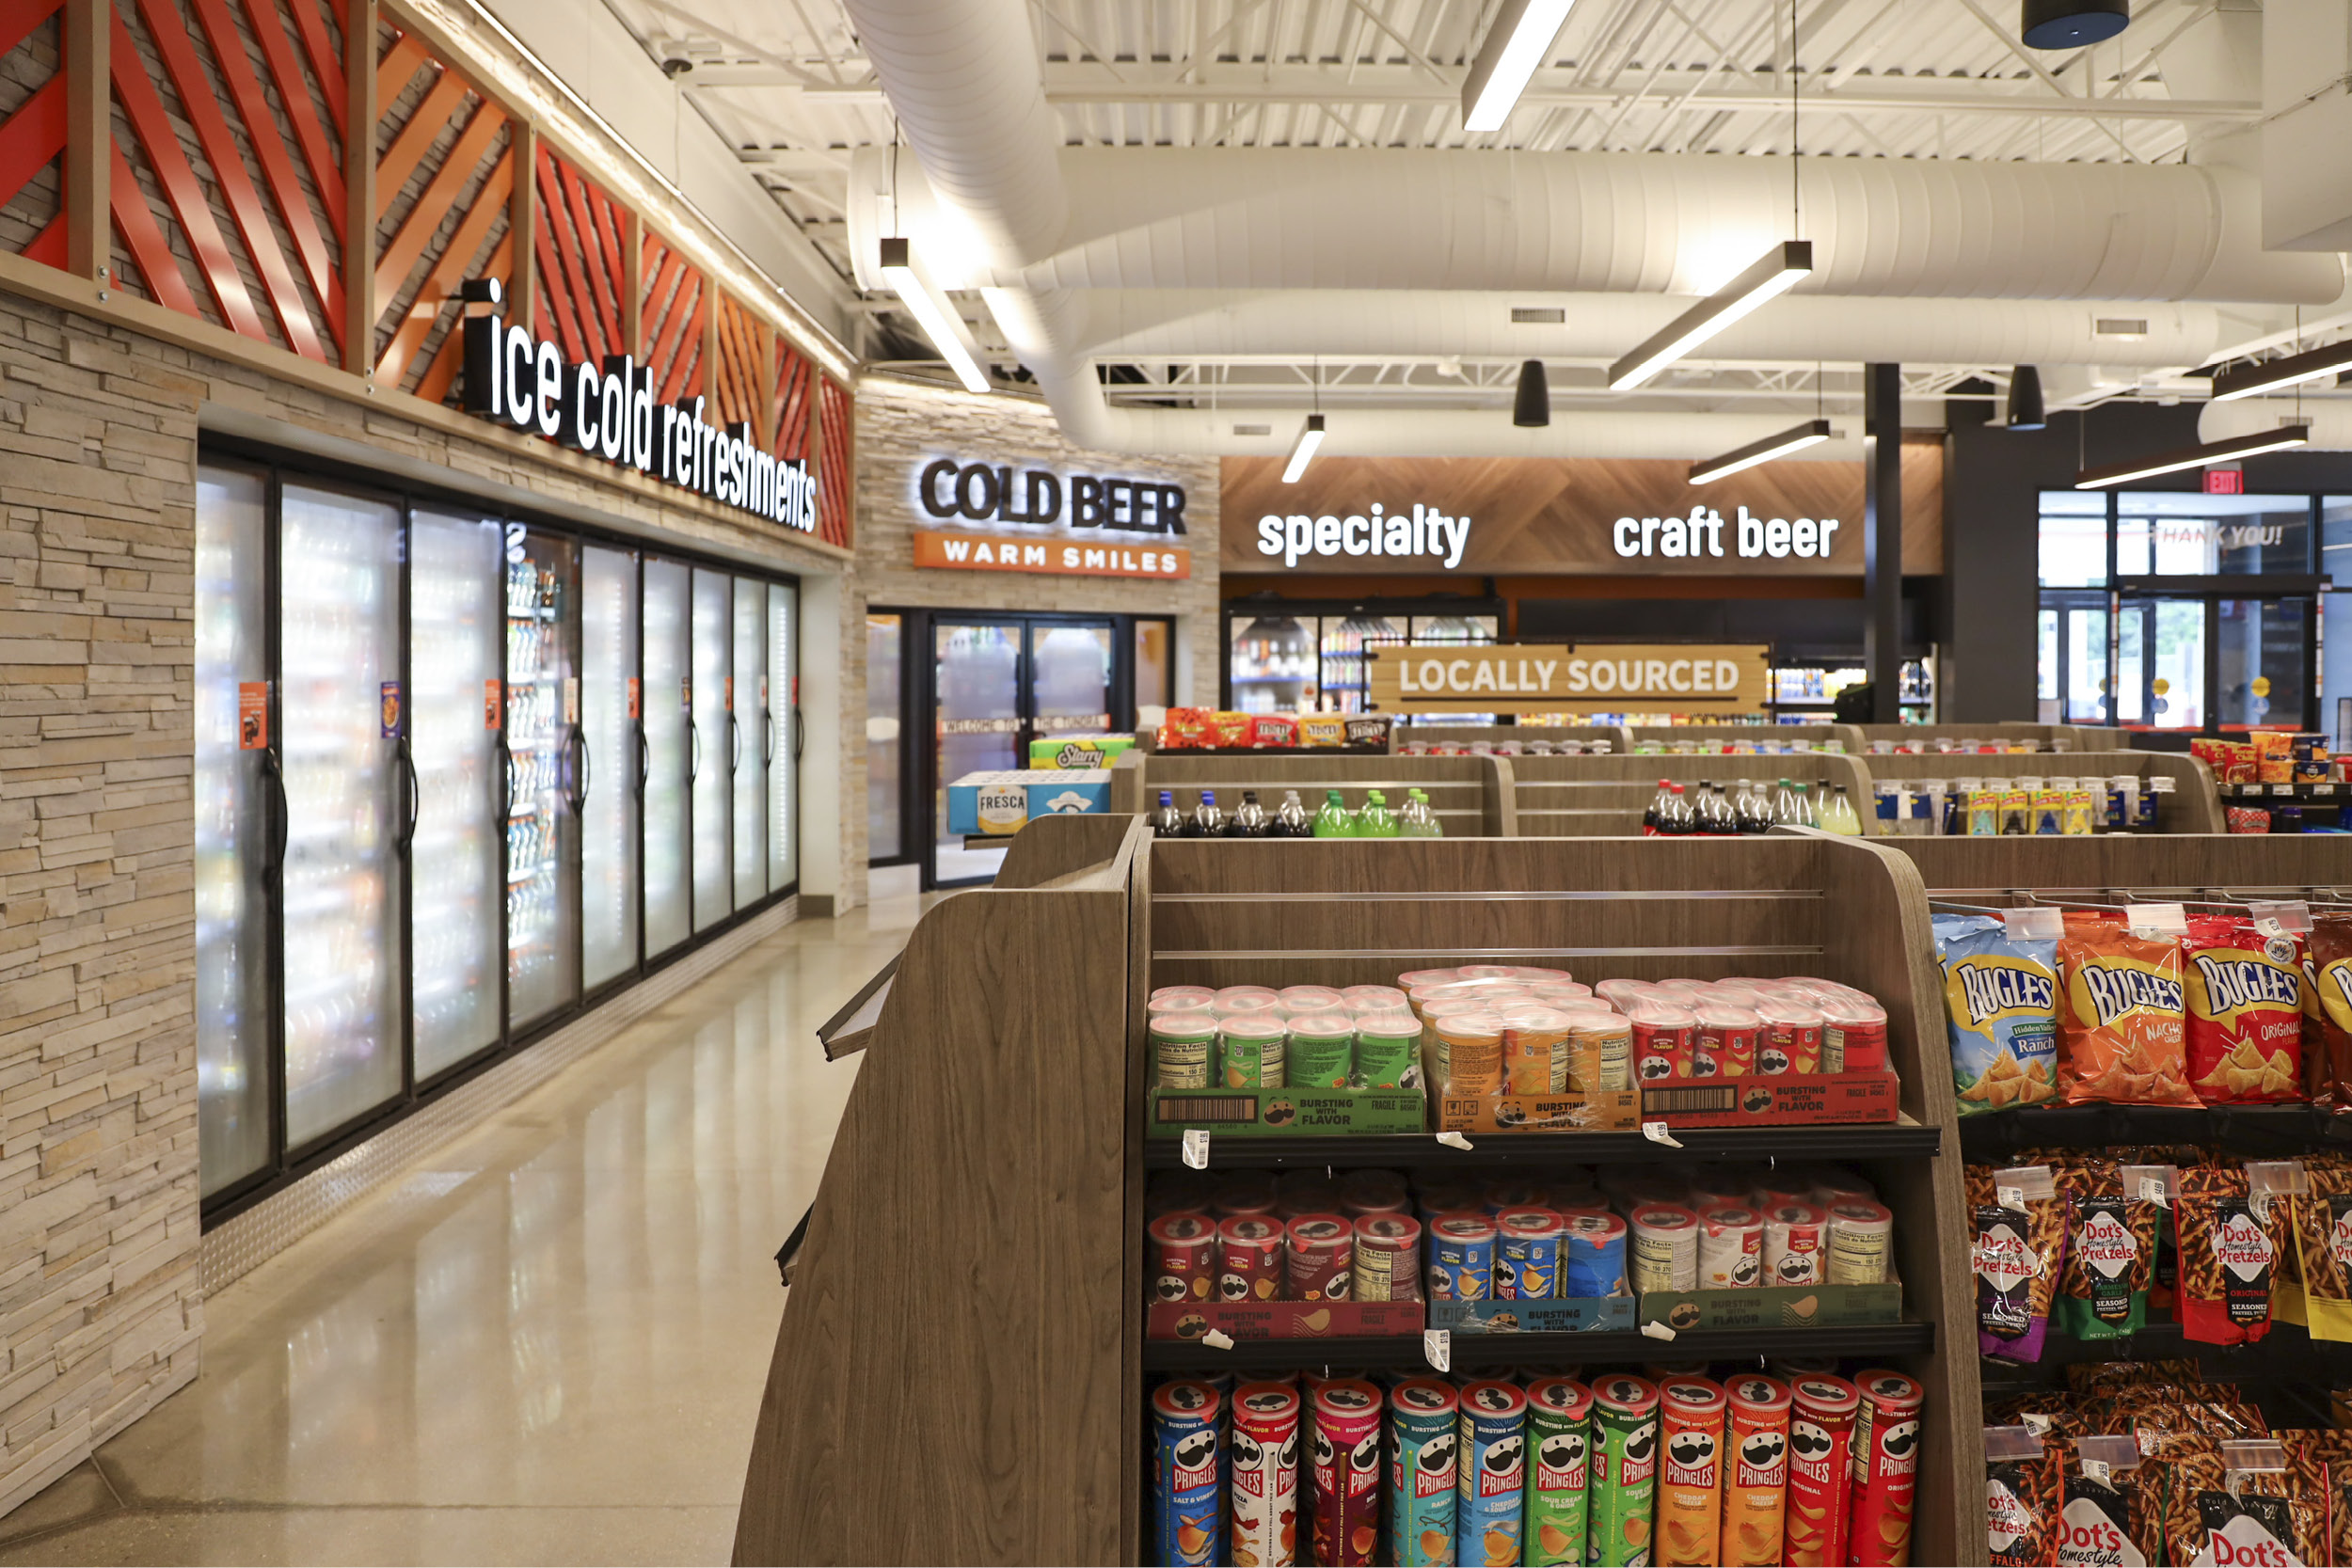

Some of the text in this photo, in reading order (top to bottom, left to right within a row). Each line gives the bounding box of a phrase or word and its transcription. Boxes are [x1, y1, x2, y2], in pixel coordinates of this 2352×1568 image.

[490, 277, 817, 532] ice cold refreshments
[920, 459, 1187, 534] COLD BEER
[1257, 502, 1839, 568] specialty craft beer
[2231, 526, 2283, 546] YOU!
[943, 540, 1178, 573] WARM SMILES
[1400, 659, 1740, 692] LOCALLY SOURCED
[946, 716, 1100, 733] WELCOME TO THE TUNDRA
[1057, 744, 1104, 768] Starry
[980, 796, 1025, 810] FRESCA
[2193, 955, 2297, 1015] BUGLES
[1957, 963, 2054, 1025] BUGLES
[2081, 965, 2184, 1026] BUGLES
[2014, 1025, 2040, 1034] Hidden
[2146, 1022, 2182, 1040] NACHO
[2017, 1037, 2055, 1053] Ranch
[1776, 1086, 1826, 1095] BURSTING
[1300, 1099, 1353, 1108] BURSTING
[1372, 1101, 1395, 1110] FRAGILE
[1536, 1101, 1586, 1112] BURSTING
[1778, 1101, 1824, 1111] FLAVOR
[1302, 1115, 1351, 1125] FLAVOR
[2086, 1222, 2123, 1239] Dot's
[2223, 1224, 2261, 1242] Dot's
[1981, 1232, 2023, 1254] Dot's
[2087, 1238, 2123, 1250] Homestyle
[2224, 1242, 2262, 1254] Homestyle
[2081, 1244, 2134, 1260] Pretzels
[2218, 1248, 2270, 1263] Pretzels
[1974, 1257, 2032, 1276] Pretzels
[1711, 1299, 1761, 1308] BURSTING
[1529, 1309, 1581, 1319] BURSTING
[1713, 1316, 1758, 1325] FLAVOR
[1221, 1327, 1270, 1338] FLAVOR
[1322, 1421, 1372, 1433] FLAVOR BURSTING
[1535, 1418, 1562, 1429] BURSTING
[1665, 1413, 1691, 1426] BURSTING
[1736, 1417, 1764, 1427] BURSTING
[1175, 1464, 1216, 1490] PRINGLES
[1483, 1466, 1523, 1495] PRINGLES
[1538, 1465, 1583, 1488] PRINGLES
[1667, 1461, 1712, 1486] PRINGLES
[1740, 1463, 1784, 1485] PRINGLES
[1791, 1479, 1821, 1495] ORIGINAL
[1431, 1497, 1452, 1508] RANCH
[1540, 1495, 1582, 1504] SOUR CREAM
[1674, 1492, 1707, 1500] CHEDDAR
[1988, 1494, 2015, 1512] ot's
[2212, 1532, 2288, 1567] Dot's
[1990, 1554, 2022, 1567] FFALO
